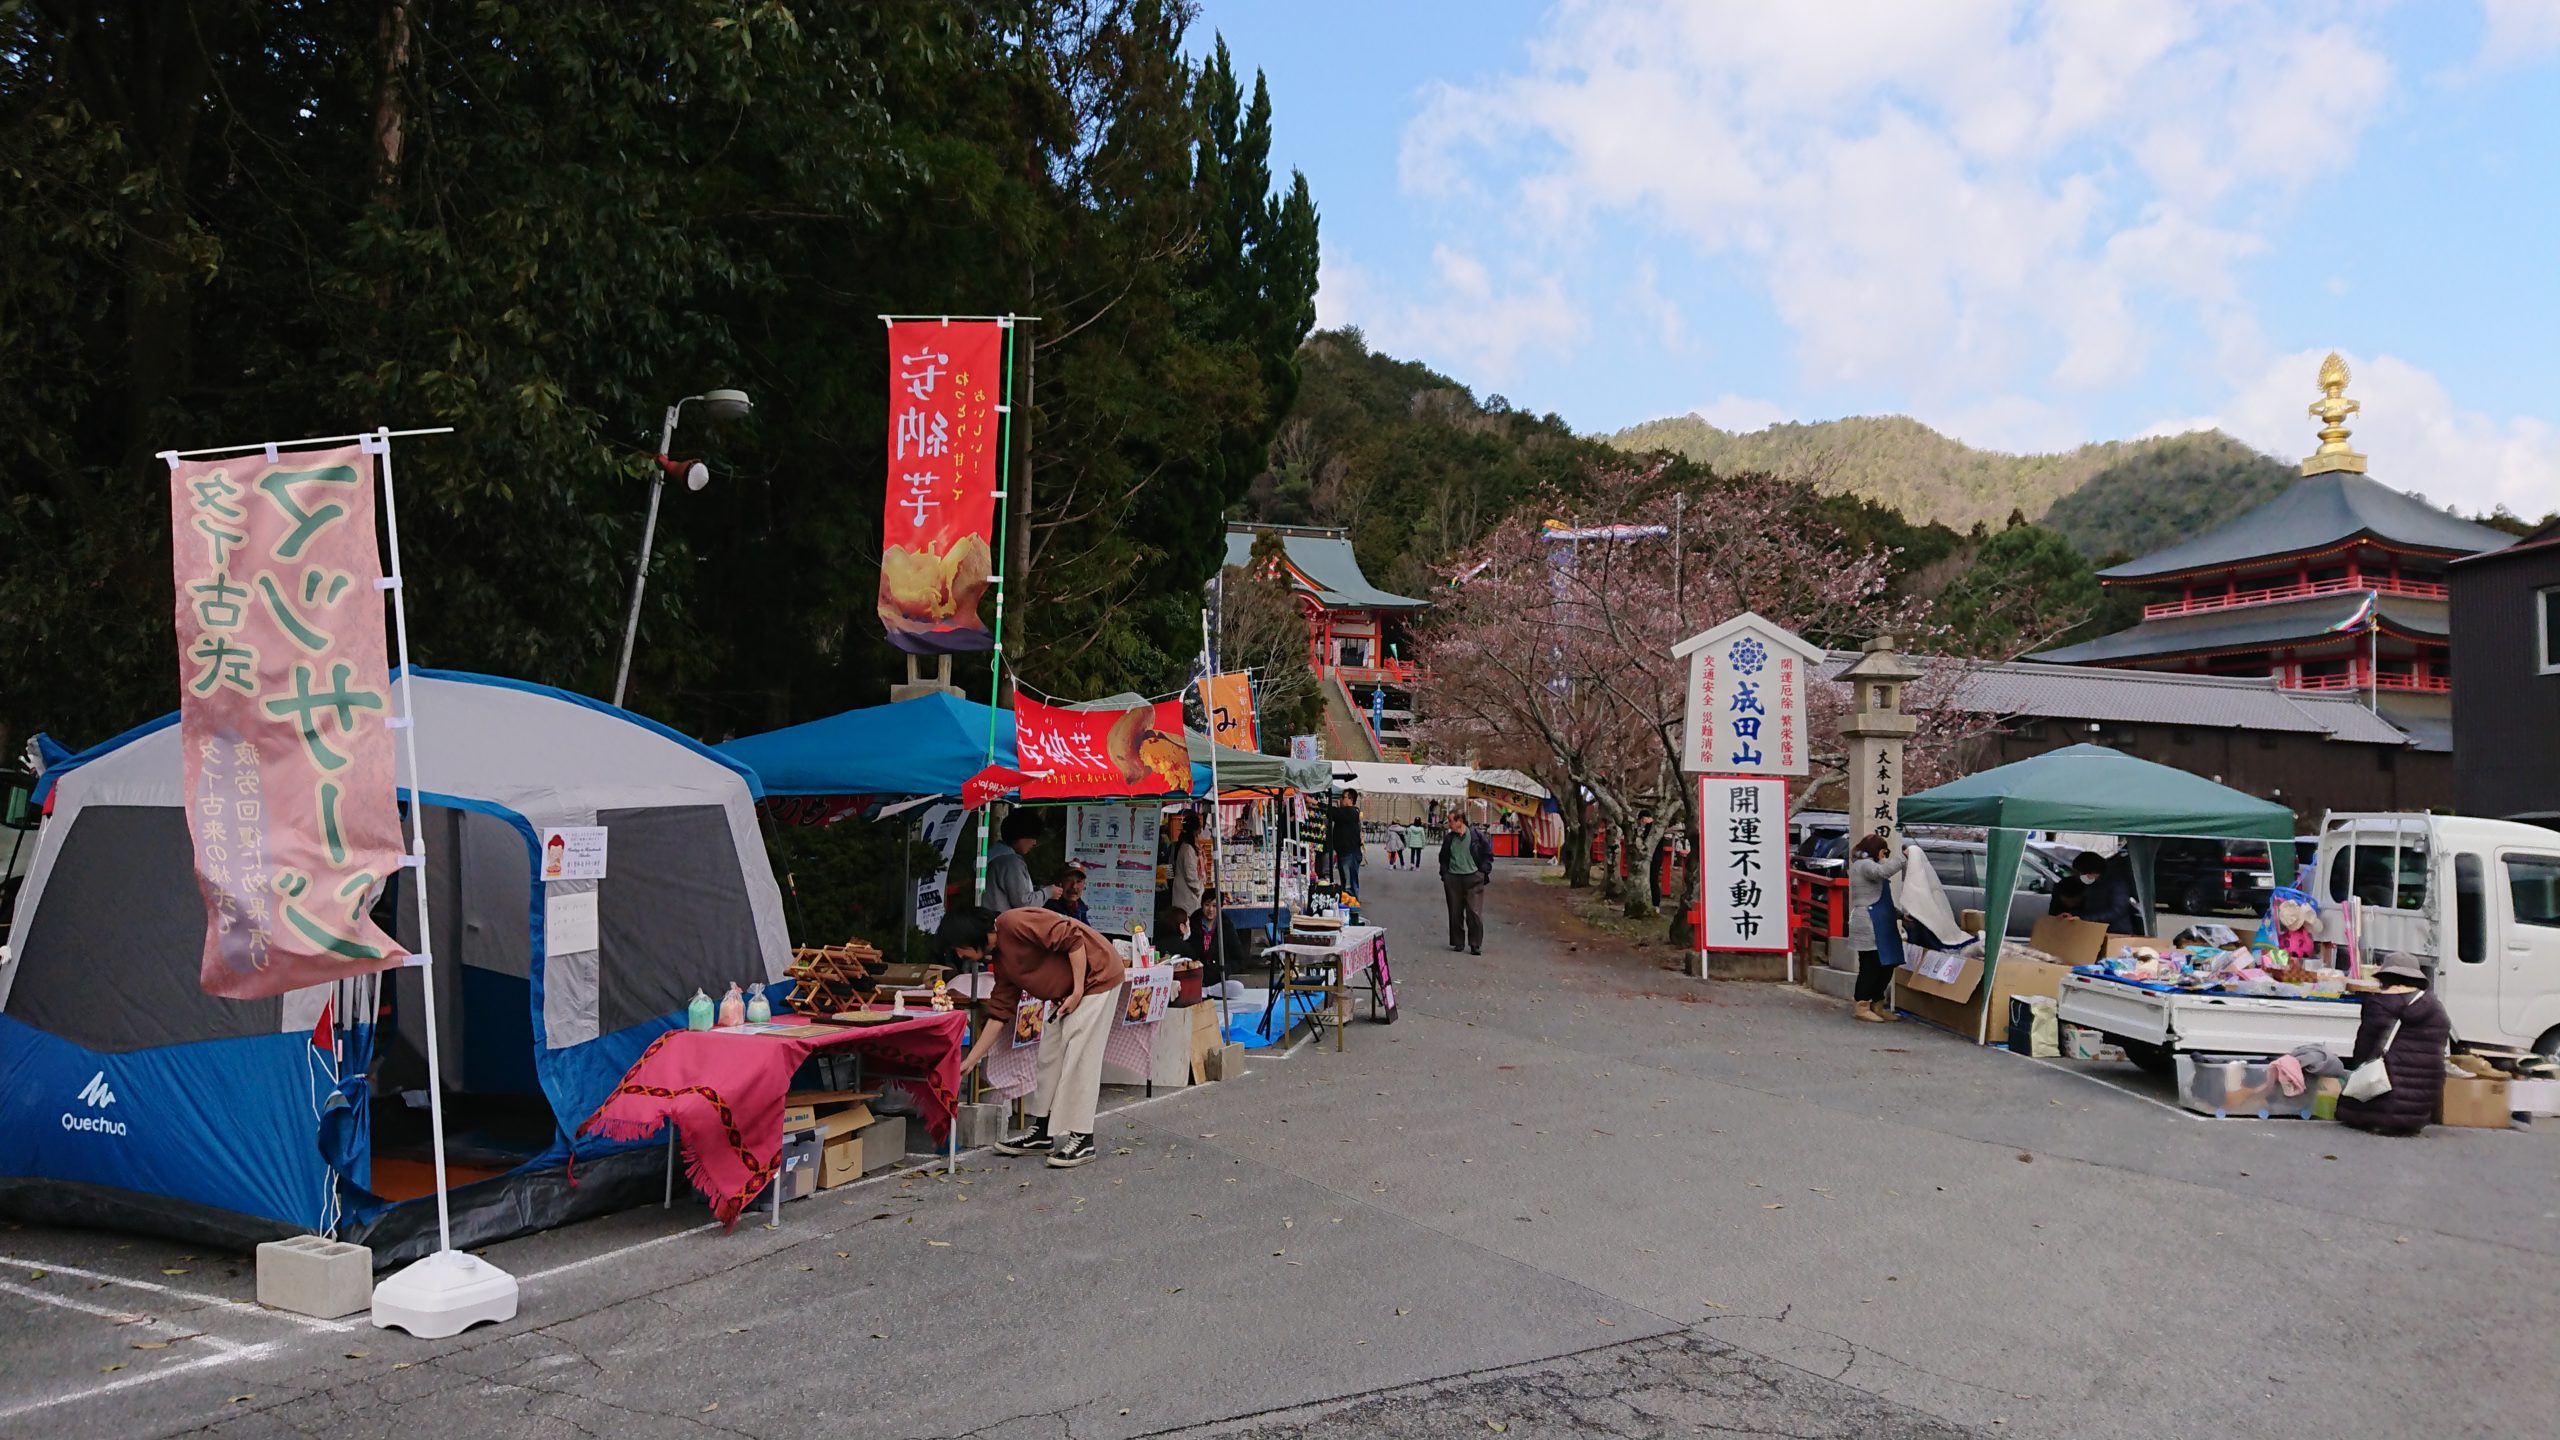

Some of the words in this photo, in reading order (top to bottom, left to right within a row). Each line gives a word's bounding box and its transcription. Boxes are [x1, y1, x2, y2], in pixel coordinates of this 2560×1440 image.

[1702, 655, 1716, 706] 交通安全
[1701, 711, 1714, 764] 災難消除
[1730, 681, 1766, 766] 成田山
[1728, 786, 1764, 942] 開運不動市
[62, 1112, 127, 1136] Quechua
